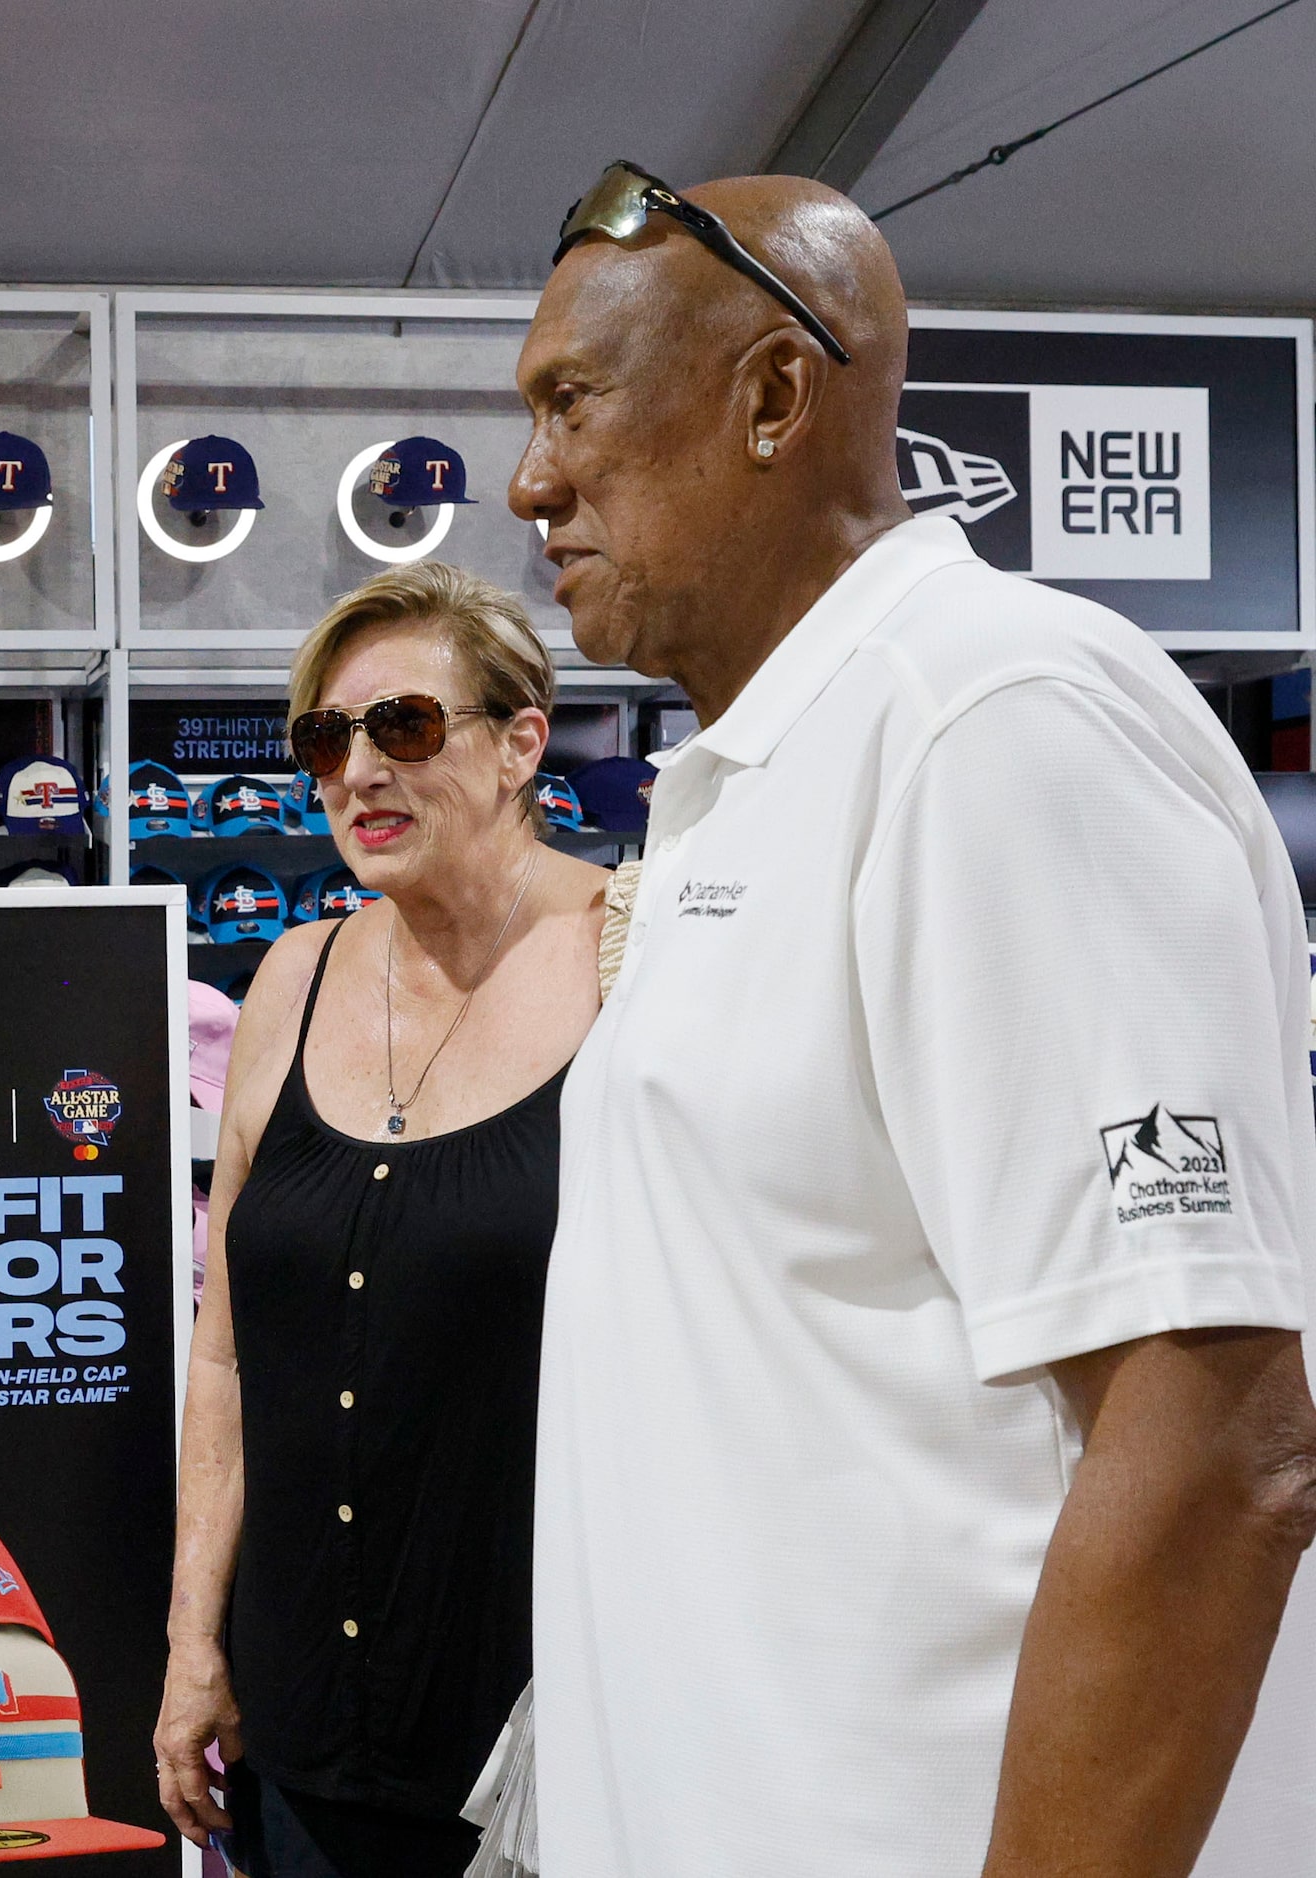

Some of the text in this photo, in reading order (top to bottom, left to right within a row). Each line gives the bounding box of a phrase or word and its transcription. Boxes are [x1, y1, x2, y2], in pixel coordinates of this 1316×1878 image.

[1060, 430, 1181, 480] NEW
[207, 462, 235, 494] T
[425, 460, 452, 492] T
[1061, 485, 1182, 535] ERA
[34, 781, 60, 810] T
[343, 885, 362, 911] LA
[63, 1104, 108, 1119] GAME
[1180, 1155, 1220, 1173] 2023
[1129, 1177, 1231, 1201] Chatham-Kent
[1117, 1201, 1176, 1225] Business
[82, 1364, 127, 1383] CAP
[54, 1385, 130, 1405] GAME™
